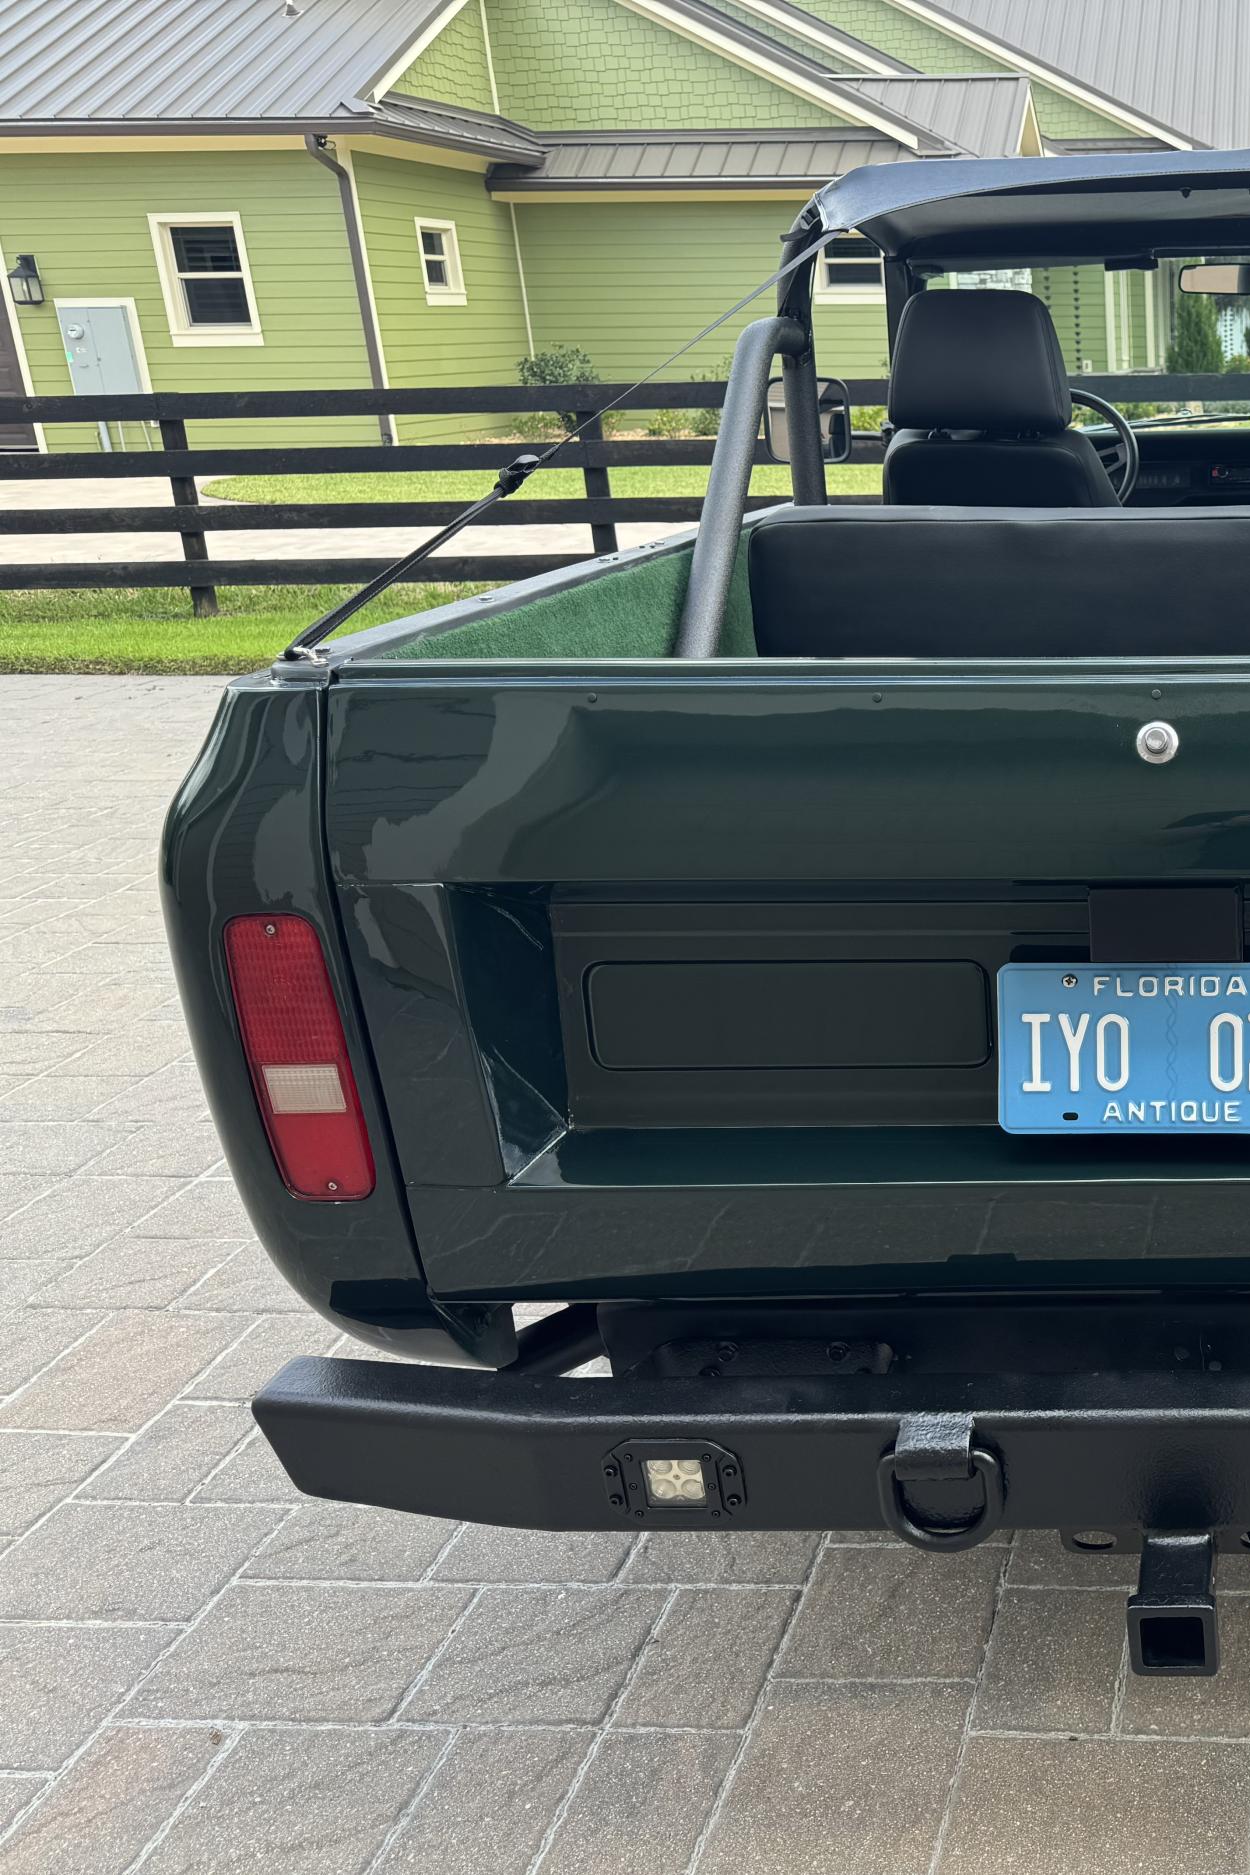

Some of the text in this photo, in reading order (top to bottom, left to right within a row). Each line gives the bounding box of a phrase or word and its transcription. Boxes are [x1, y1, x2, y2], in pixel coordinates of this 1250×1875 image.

[1093, 976, 1249, 997] FLORIDA
[1021, 1012, 1130, 1092] IYO
[1102, 1101, 1242, 1122] ANTIQUE
